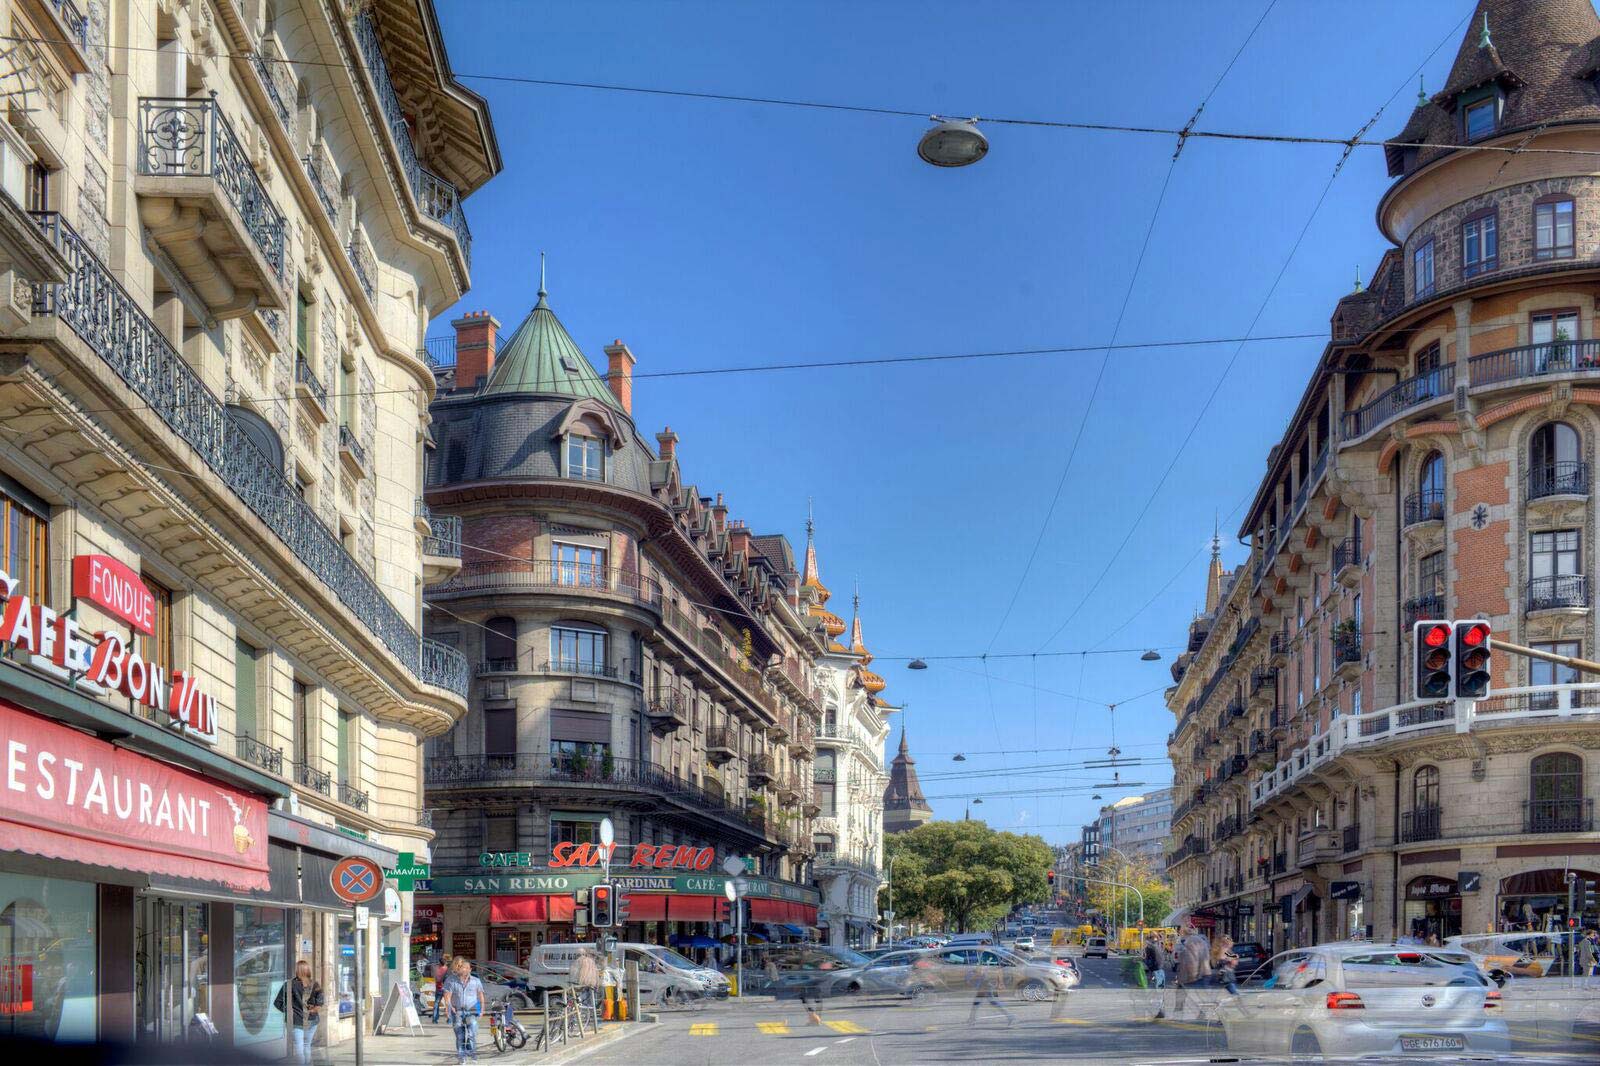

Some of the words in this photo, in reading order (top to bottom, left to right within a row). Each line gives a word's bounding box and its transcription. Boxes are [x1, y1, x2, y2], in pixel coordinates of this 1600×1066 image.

[92, 560, 151, 628] FONDUE
[97, 631, 164, 710] BON
[479, 852, 532, 867] CAFE
[548, 842, 617, 868] SAN
[630, 842, 716, 871] REMO
[385, 867, 425, 877] AMAVITA
[464, 878, 500, 891] SAN
[510, 877, 569, 889] REMO
[610, 878, 672, 889] CARDINAL
